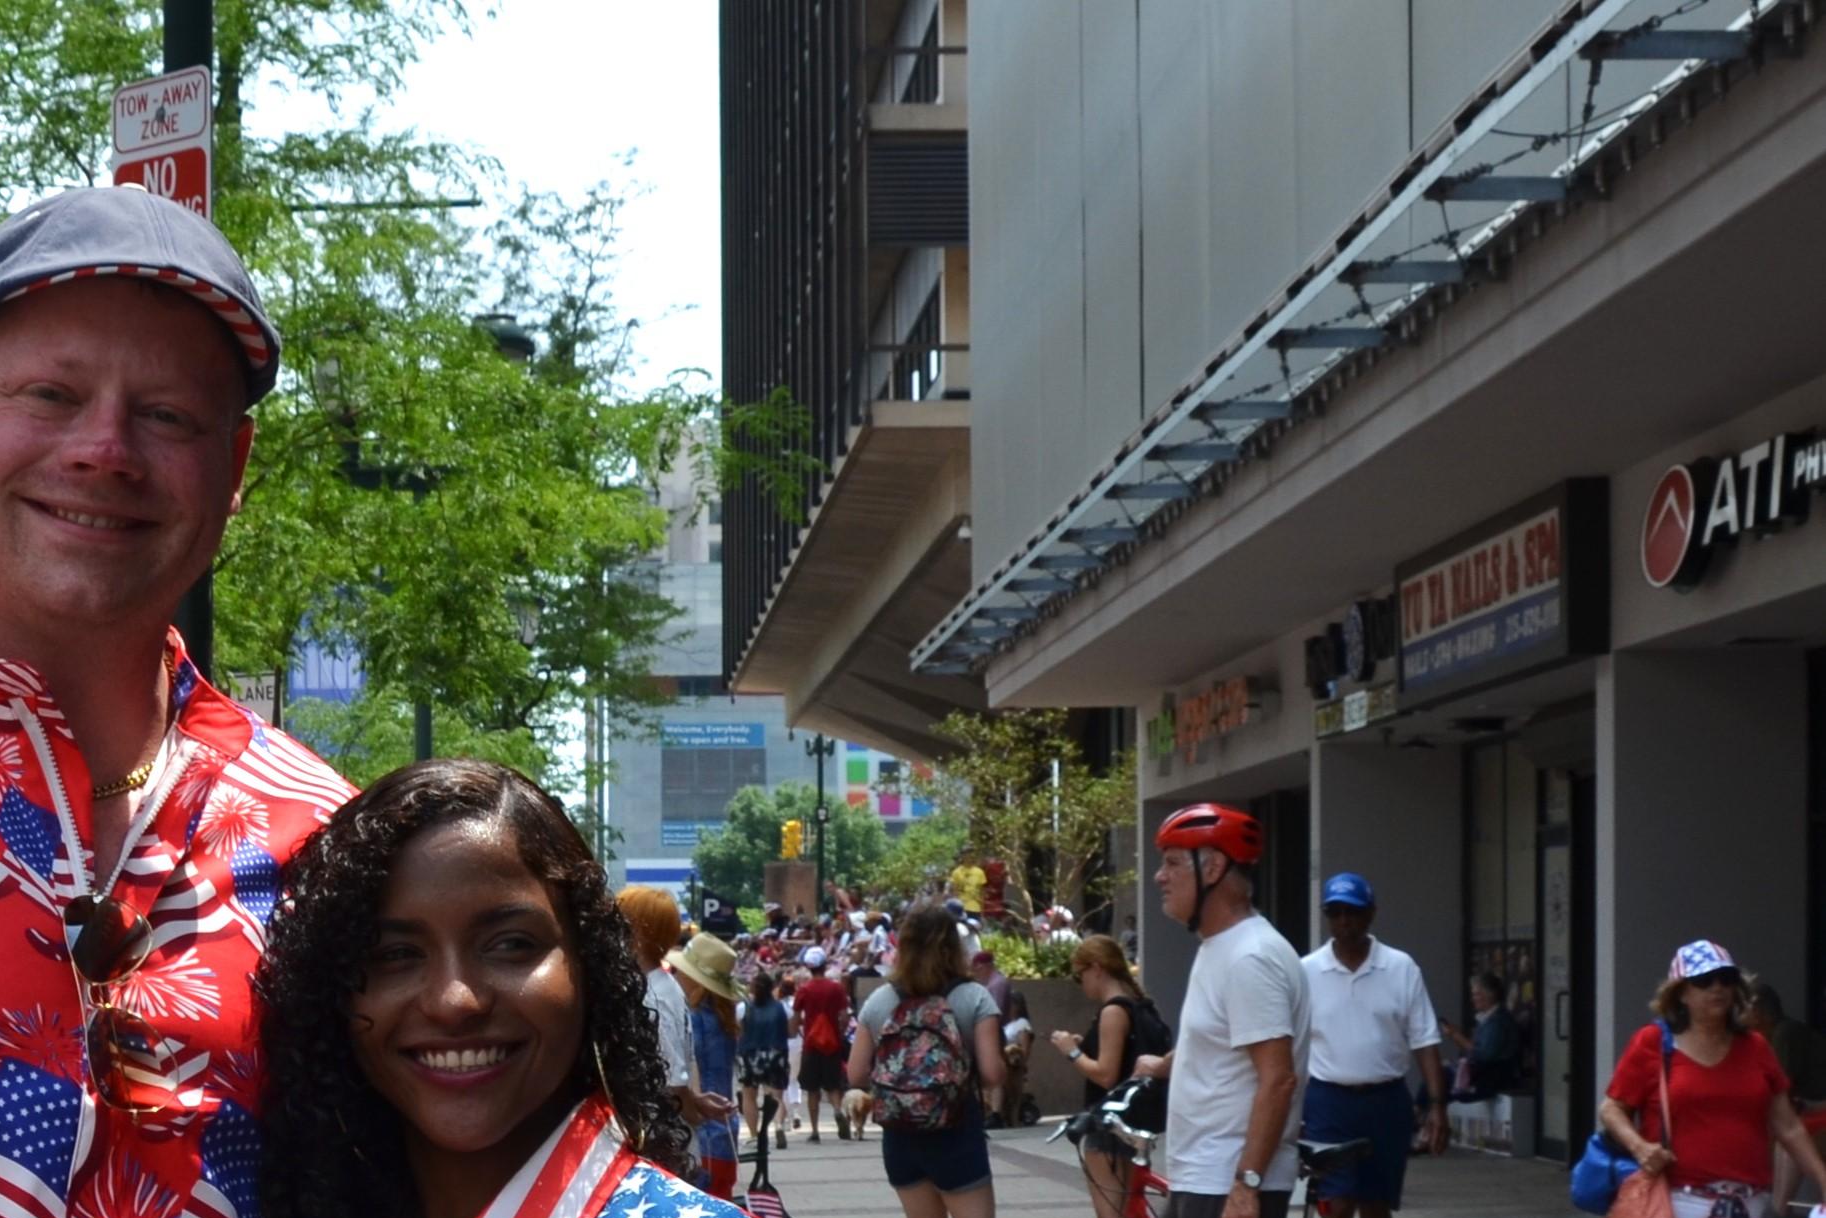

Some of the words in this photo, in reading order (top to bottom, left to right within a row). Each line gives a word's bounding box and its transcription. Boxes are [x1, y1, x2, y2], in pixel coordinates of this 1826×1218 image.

[120, 94, 148, 117] TOW
[162, 80, 202, 107] AWAY
[141, 113, 179, 141] ZONE
[143, 157, 177, 198] NO
[1702, 433, 1785, 547] ATI
[1451, 542, 1502, 619] NAILS
[1506, 536, 1519, 595] &
[1525, 516, 1561, 588] SPA
